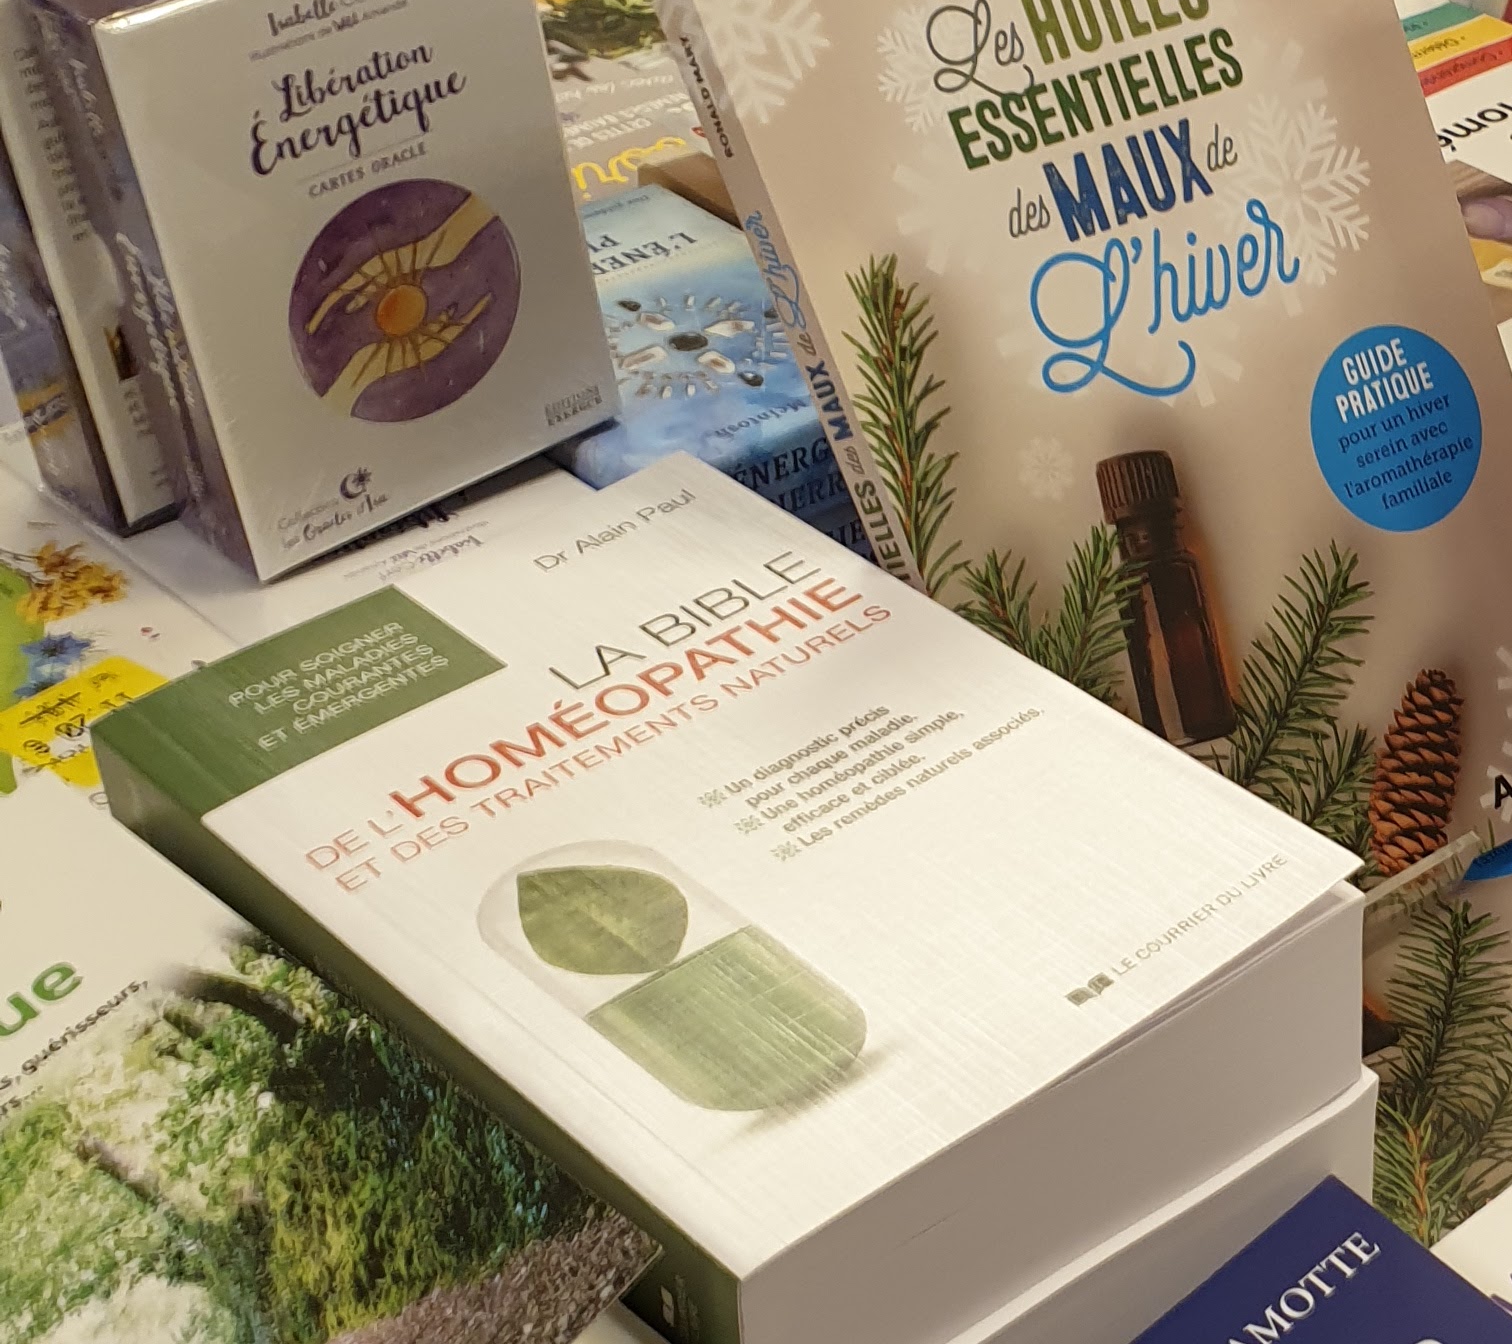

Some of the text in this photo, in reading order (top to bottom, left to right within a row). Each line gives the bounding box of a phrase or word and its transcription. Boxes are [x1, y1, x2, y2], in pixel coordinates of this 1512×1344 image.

[270, 43, 434, 124] Libération
[946, 27, 1244, 172] ESSENTIELLES
[250, 69, 468, 176] Énergétique
[308, 165, 365, 199] CARTES
[1007, 117, 1239, 243] des MAUX de
[1028, 195, 1303, 398] L'hiver
[1334, 362, 1435, 425] PRATIQUE
[1341, 337, 1408, 388] GUIDE
[805, 360, 854, 442] MAUX
[1406, 391, 1453, 425] hiver
[1343, 433, 1476, 500] l'aromathérapie
[1354, 419, 1451, 471] serein avec
[575, 487, 697, 557] Alain Paul
[1380, 466, 1455, 511] familiale
[547, 549, 823, 692] LA BIBLE
[227, 620, 404, 708] POUR SOIGNER
[292, 643, 435, 715] COURANTES
[292, 654, 450, 734] ÉMERGENTES
[302, 632, 419, 692] MALADIES
[334, 603, 894, 895] ET DES TRAITEMENTS NATURELS
[752, 704, 891, 783] diagnostic précis
[787, 748, 848, 788] chaque
[799, 738, 906, 804] homéopathie
[782, 791, 852, 834] efficace
[833, 746, 975, 831] remèdes naturels
[304, 828, 371, 874] DE
[1134, 902, 1219, 961] COURRIER
[20, 977, 152, 1078] guérisseurs,
